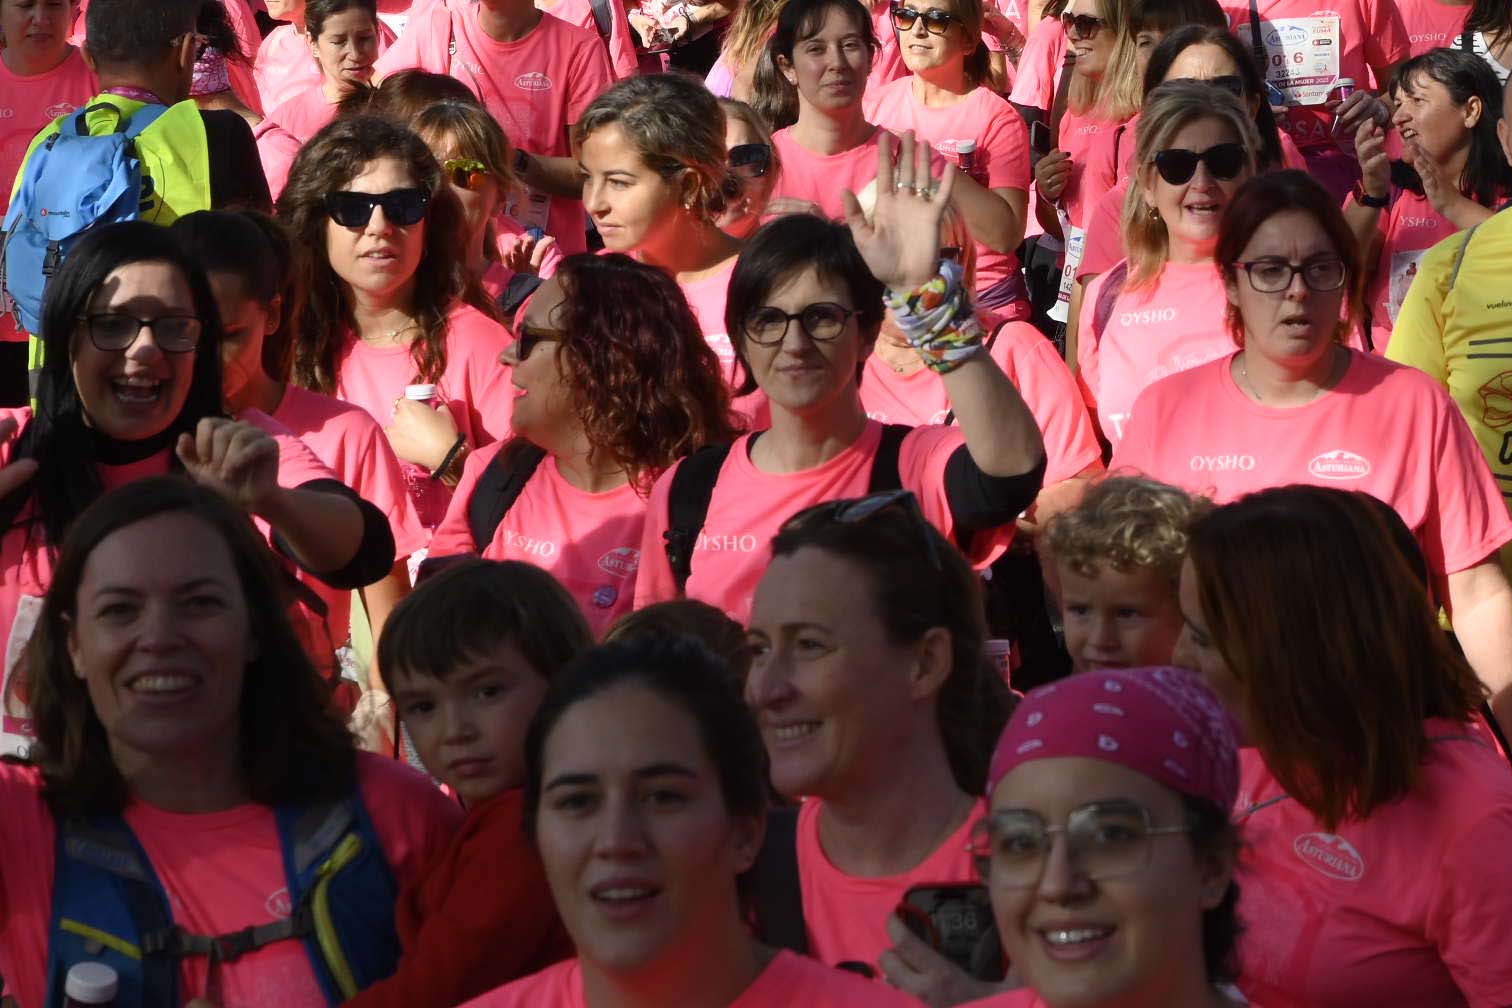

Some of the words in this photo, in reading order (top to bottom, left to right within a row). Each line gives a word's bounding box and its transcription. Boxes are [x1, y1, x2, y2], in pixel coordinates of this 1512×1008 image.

[1409, 32, 1447, 43] OYSHO
[1294, 78, 1314, 87] MUJER
[1121, 307, 1176, 326] OYSHO
[1190, 454, 1256, 472] OYSHO
